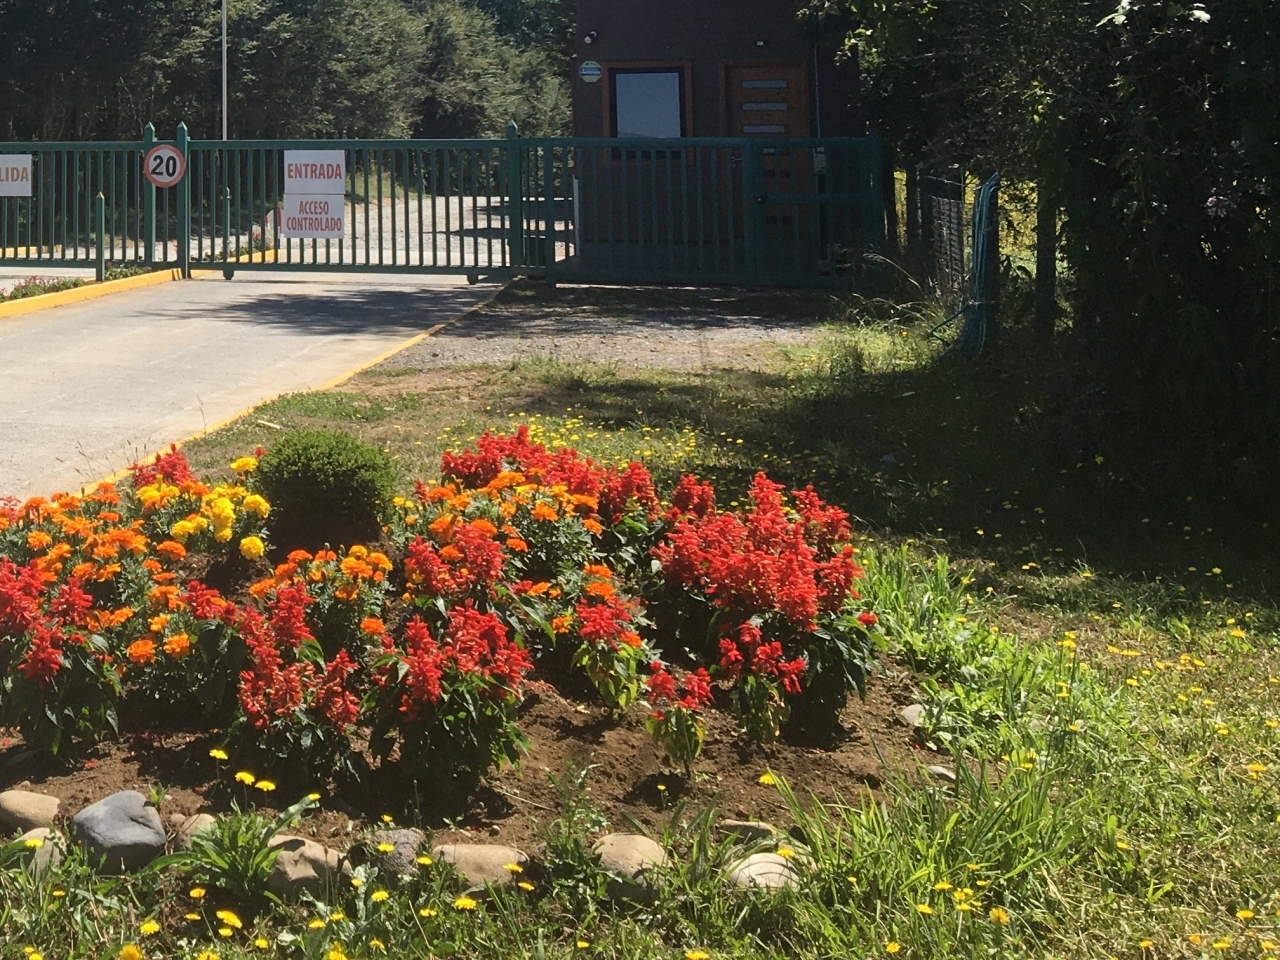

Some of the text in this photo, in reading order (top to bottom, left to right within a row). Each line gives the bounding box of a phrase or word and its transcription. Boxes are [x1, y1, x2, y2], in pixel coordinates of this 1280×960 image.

[151, 155, 177, 177] 20
[287, 163, 342, 179] ENTRADA
[299, 201, 329, 215] ACCESO
[286, 217, 342, 231] CONTROLADO
